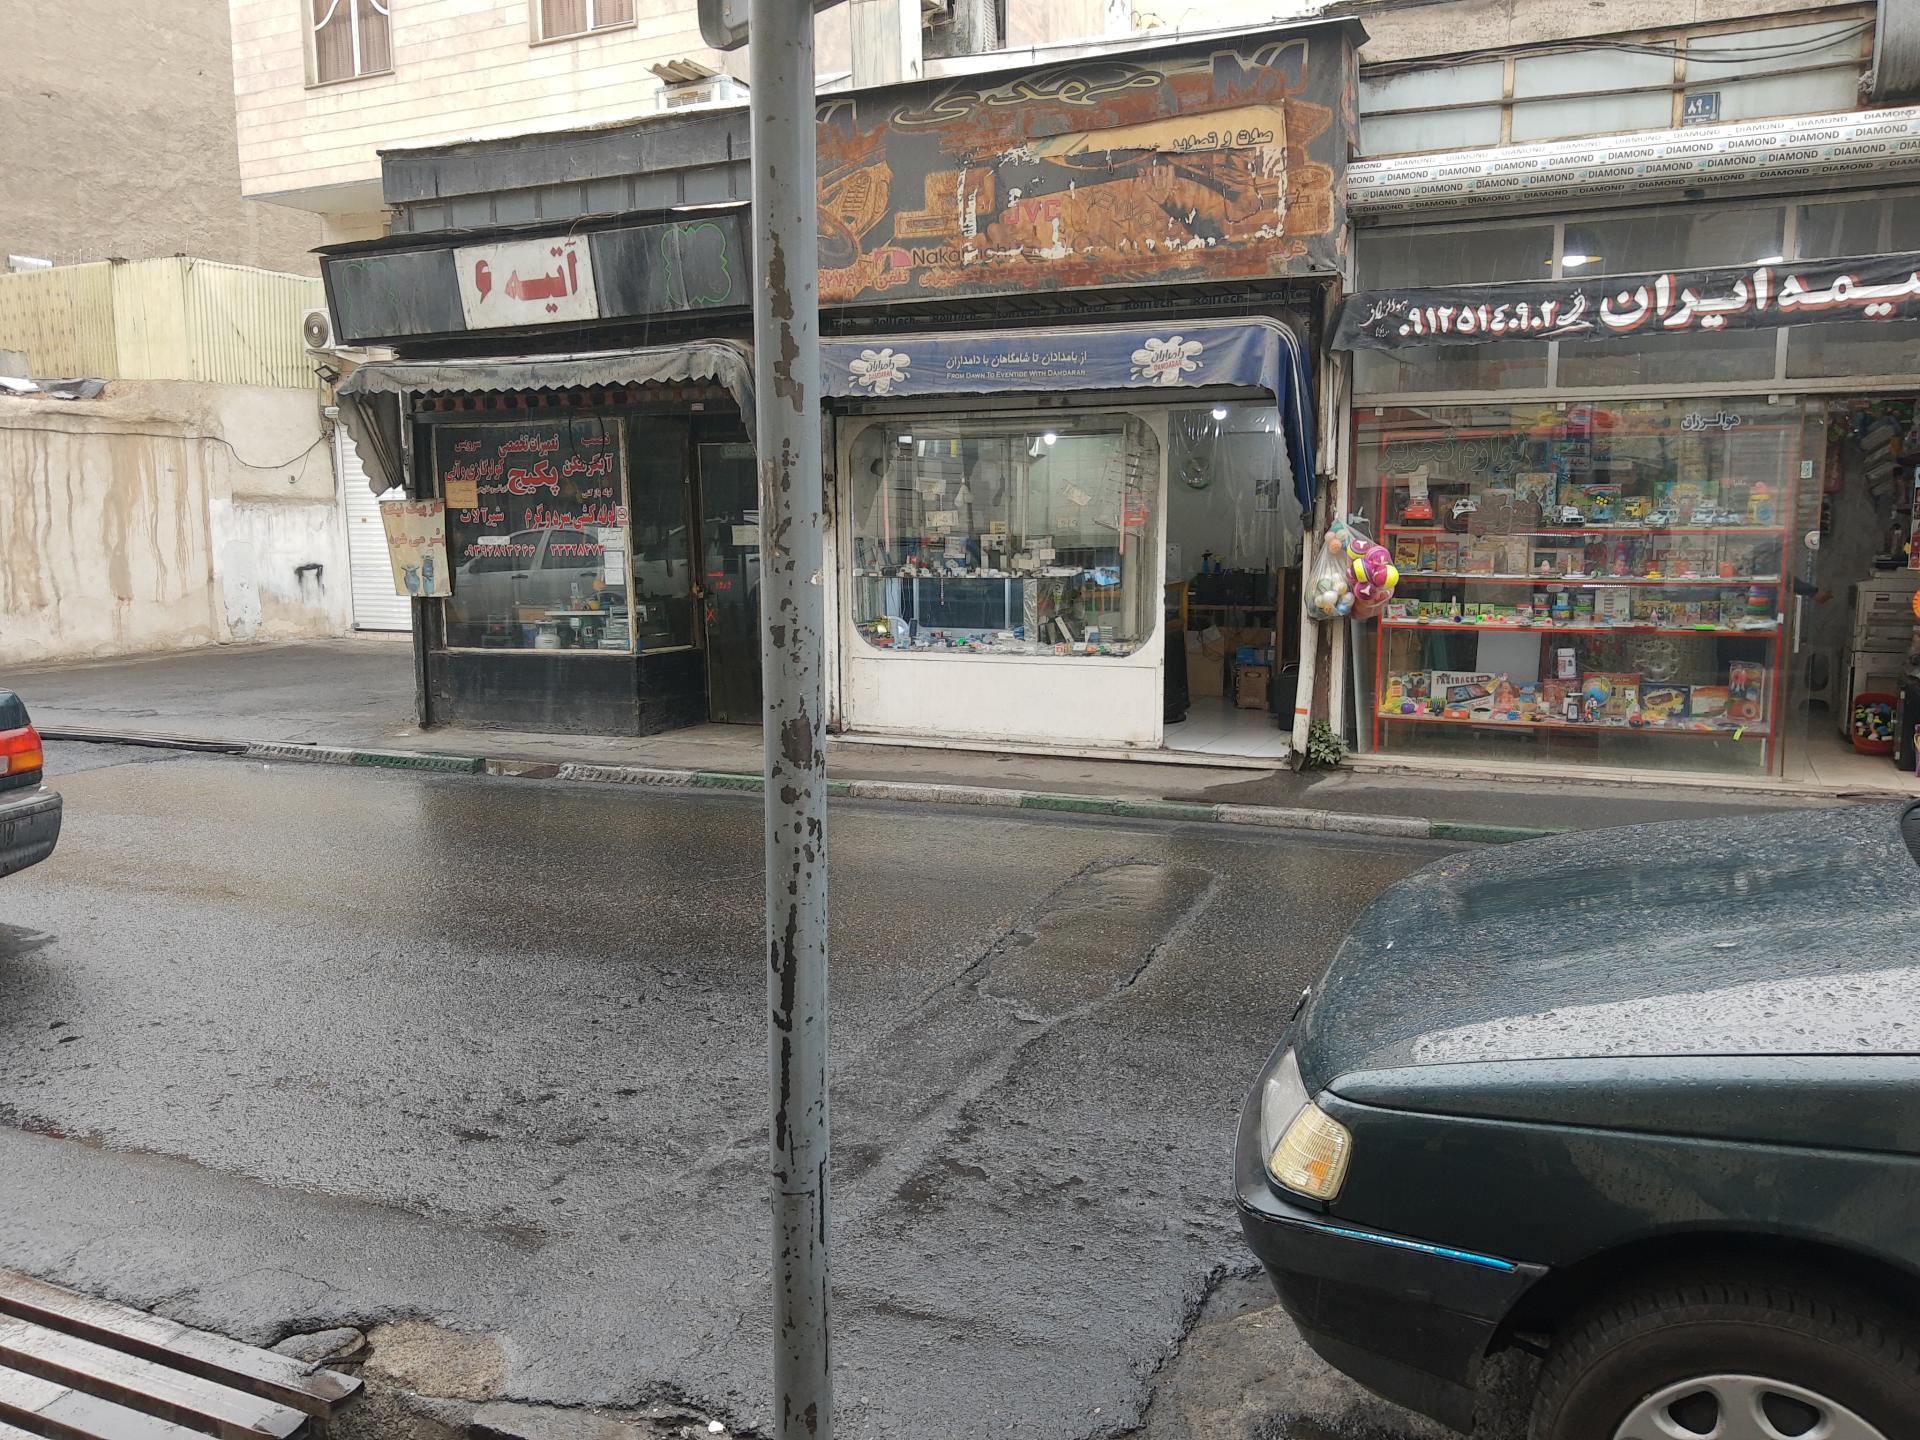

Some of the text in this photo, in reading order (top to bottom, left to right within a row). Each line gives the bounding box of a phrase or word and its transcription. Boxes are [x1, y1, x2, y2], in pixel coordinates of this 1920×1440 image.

[1688, 98, 1710, 115] ۸۹۰
[1172, 131, 1218, 150] تصویر
[1236, 127, 1274, 146] صوت
[1347, 162, 1382, 171] IAMOND
[1394, 157, 1436, 167] DIAMOND
[1673, 130, 1721, 139] DIAMOND
[1735, 122, 1785, 133] DIAMOND
[1797, 116, 1848, 127] DIAMOND
[1863, 109, 1917, 121] DIAMOND
[1387, 170, 1429, 181] DIAMOND
[1438, 165, 1482, 177] DIAMOND
[1494, 160, 1538, 171] DIAMOND
[1548, 154, 1594, 166] DIAMOND
[1608, 148, 1655, 160] DIAMOND
[1666, 143, 1714, 155] DIAMOND
[1728, 137, 1777, 149] DIAMOND
[1789, 130, 1840, 143] DIAMOND
[1855, 124, 1908, 137] DIAMOND
[1370, 187, 1411, 199] DIAMOND
[1421, 183, 1463, 194] DIAMOND
[1476, 178, 1519, 189] DIAMOND
[1530, 172, 1575, 184] DIAMOND
[1588, 167, 1634, 179] DIAMOND
[1645, 161, 1693, 174] DIAMOND
[1707, 156, 1756, 168] DIAMOND
[1768, 150, 1819, 162] DIAMOND
[1834, 143, 1886, 156] DIAMOND
[1362, 203, 1404, 213] DIAMOND
[1415, 199, 1458, 208] DIAMOND
[1468, 194, 1511, 204] DIAMOND
[1523, 189, 1569, 199] DIAMOND
[1579, 184, 1625, 193] DIAMOND
[1638, 179, 1686, 189] DIAMOND
[1697, 173, 1745, 183] DIAMOND
[1760, 168, 1809, 178] DIAMOND
[1822, 162, 1874, 173] DIAMOND
[1003, 200, 1062, 225] JVC
[504, 240, 578, 314] آتیه
[875, 269, 910, 291] تلفن
[1192, 292, 1244, 306] RollTech
[1600, 267, 1770, 329] ایران
[946, 351, 1087, 370] از بامدادان تا شامگاهان با دامداران
[455, 438, 482, 453] سرویس
[498, 433, 560, 458] تعمیرات تخصصی
[581, 432, 611, 448] نصب
[1377, 429, 1455, 471] تحریر
[1458, 431, 1533, 472] لوازم
[562, 453, 614, 477] آبگرمکن
[508, 459, 561, 496] پکیج
[602, 487, 613, 497] لوله
[384, 499, 443, 517] گاز پیک نیک
[525, 501, 616, 530] لوله کشی سرد و گرم
[390, 532, 408, 549] شود
[408, 536, 426, 548] می
